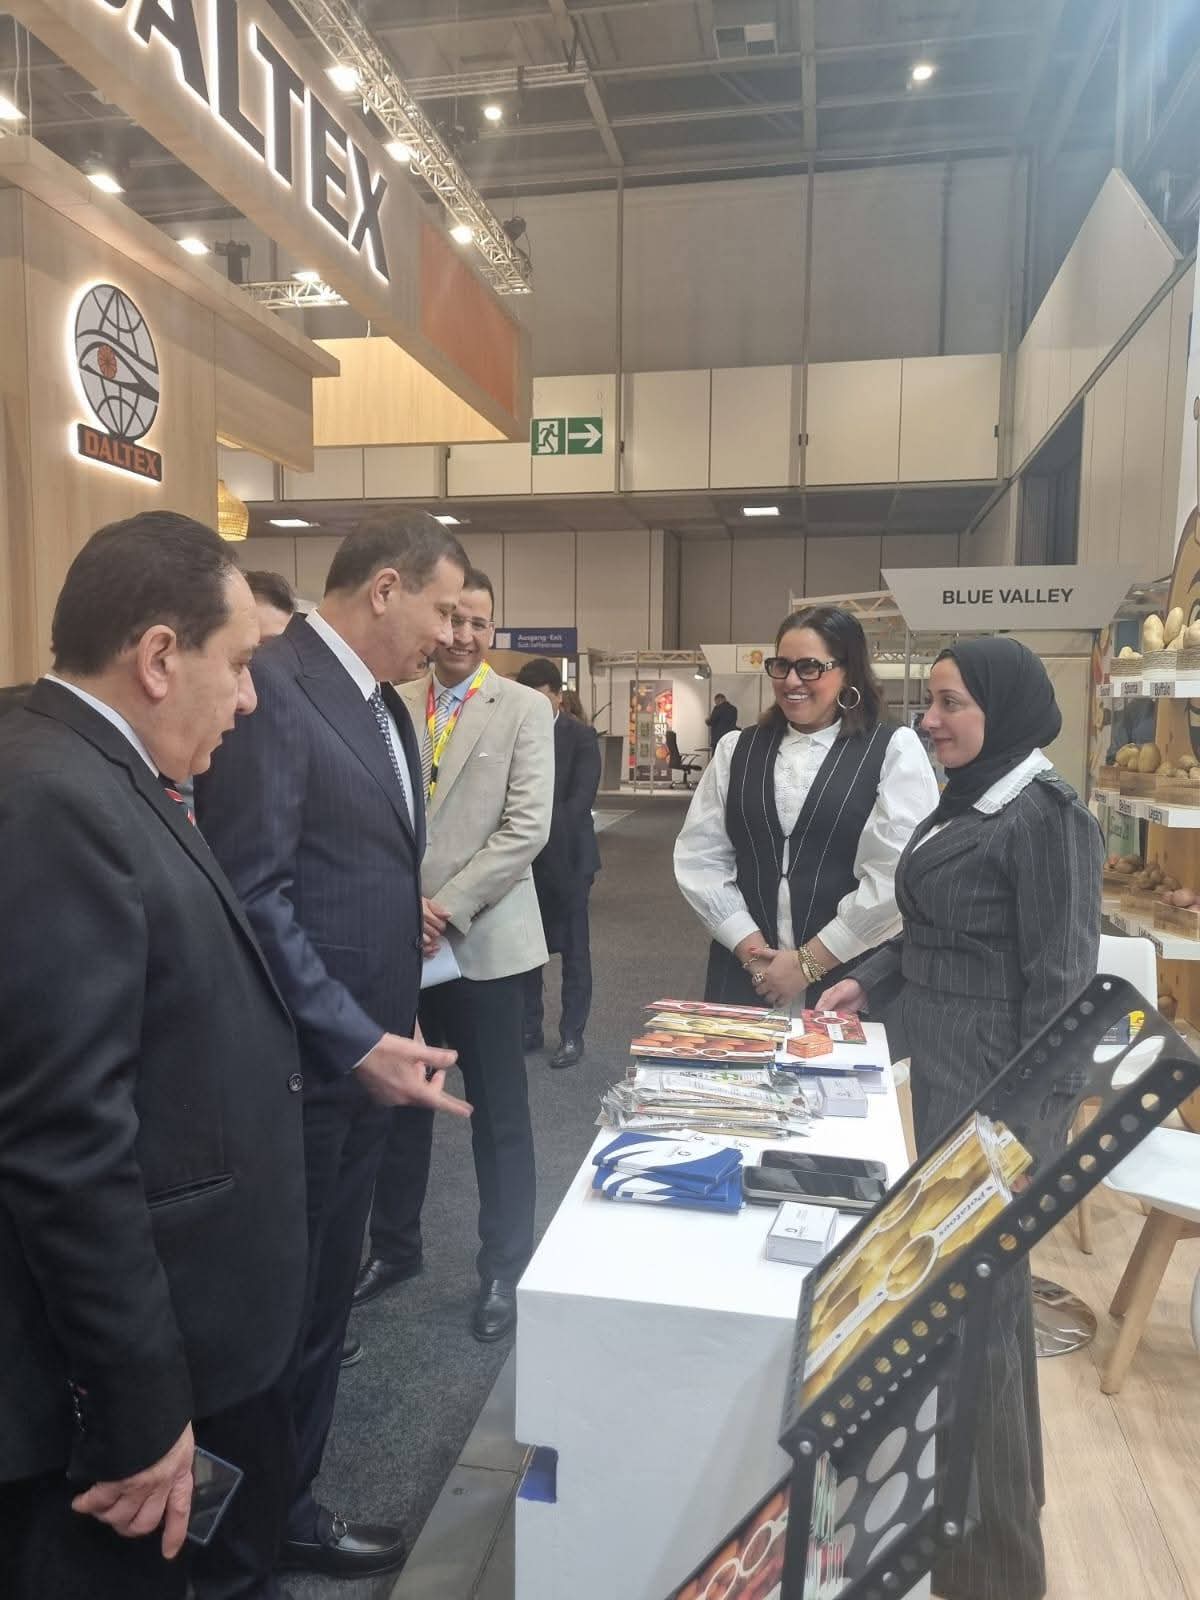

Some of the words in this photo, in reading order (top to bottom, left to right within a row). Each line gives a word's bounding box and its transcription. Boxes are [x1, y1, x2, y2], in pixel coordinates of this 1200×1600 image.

[103, 0, 389, 281] ALTEX
[84, 430, 159, 476] DALTEX
[943, 590, 993, 604] BLUE
[999, 588, 1074, 604] VALLEY
